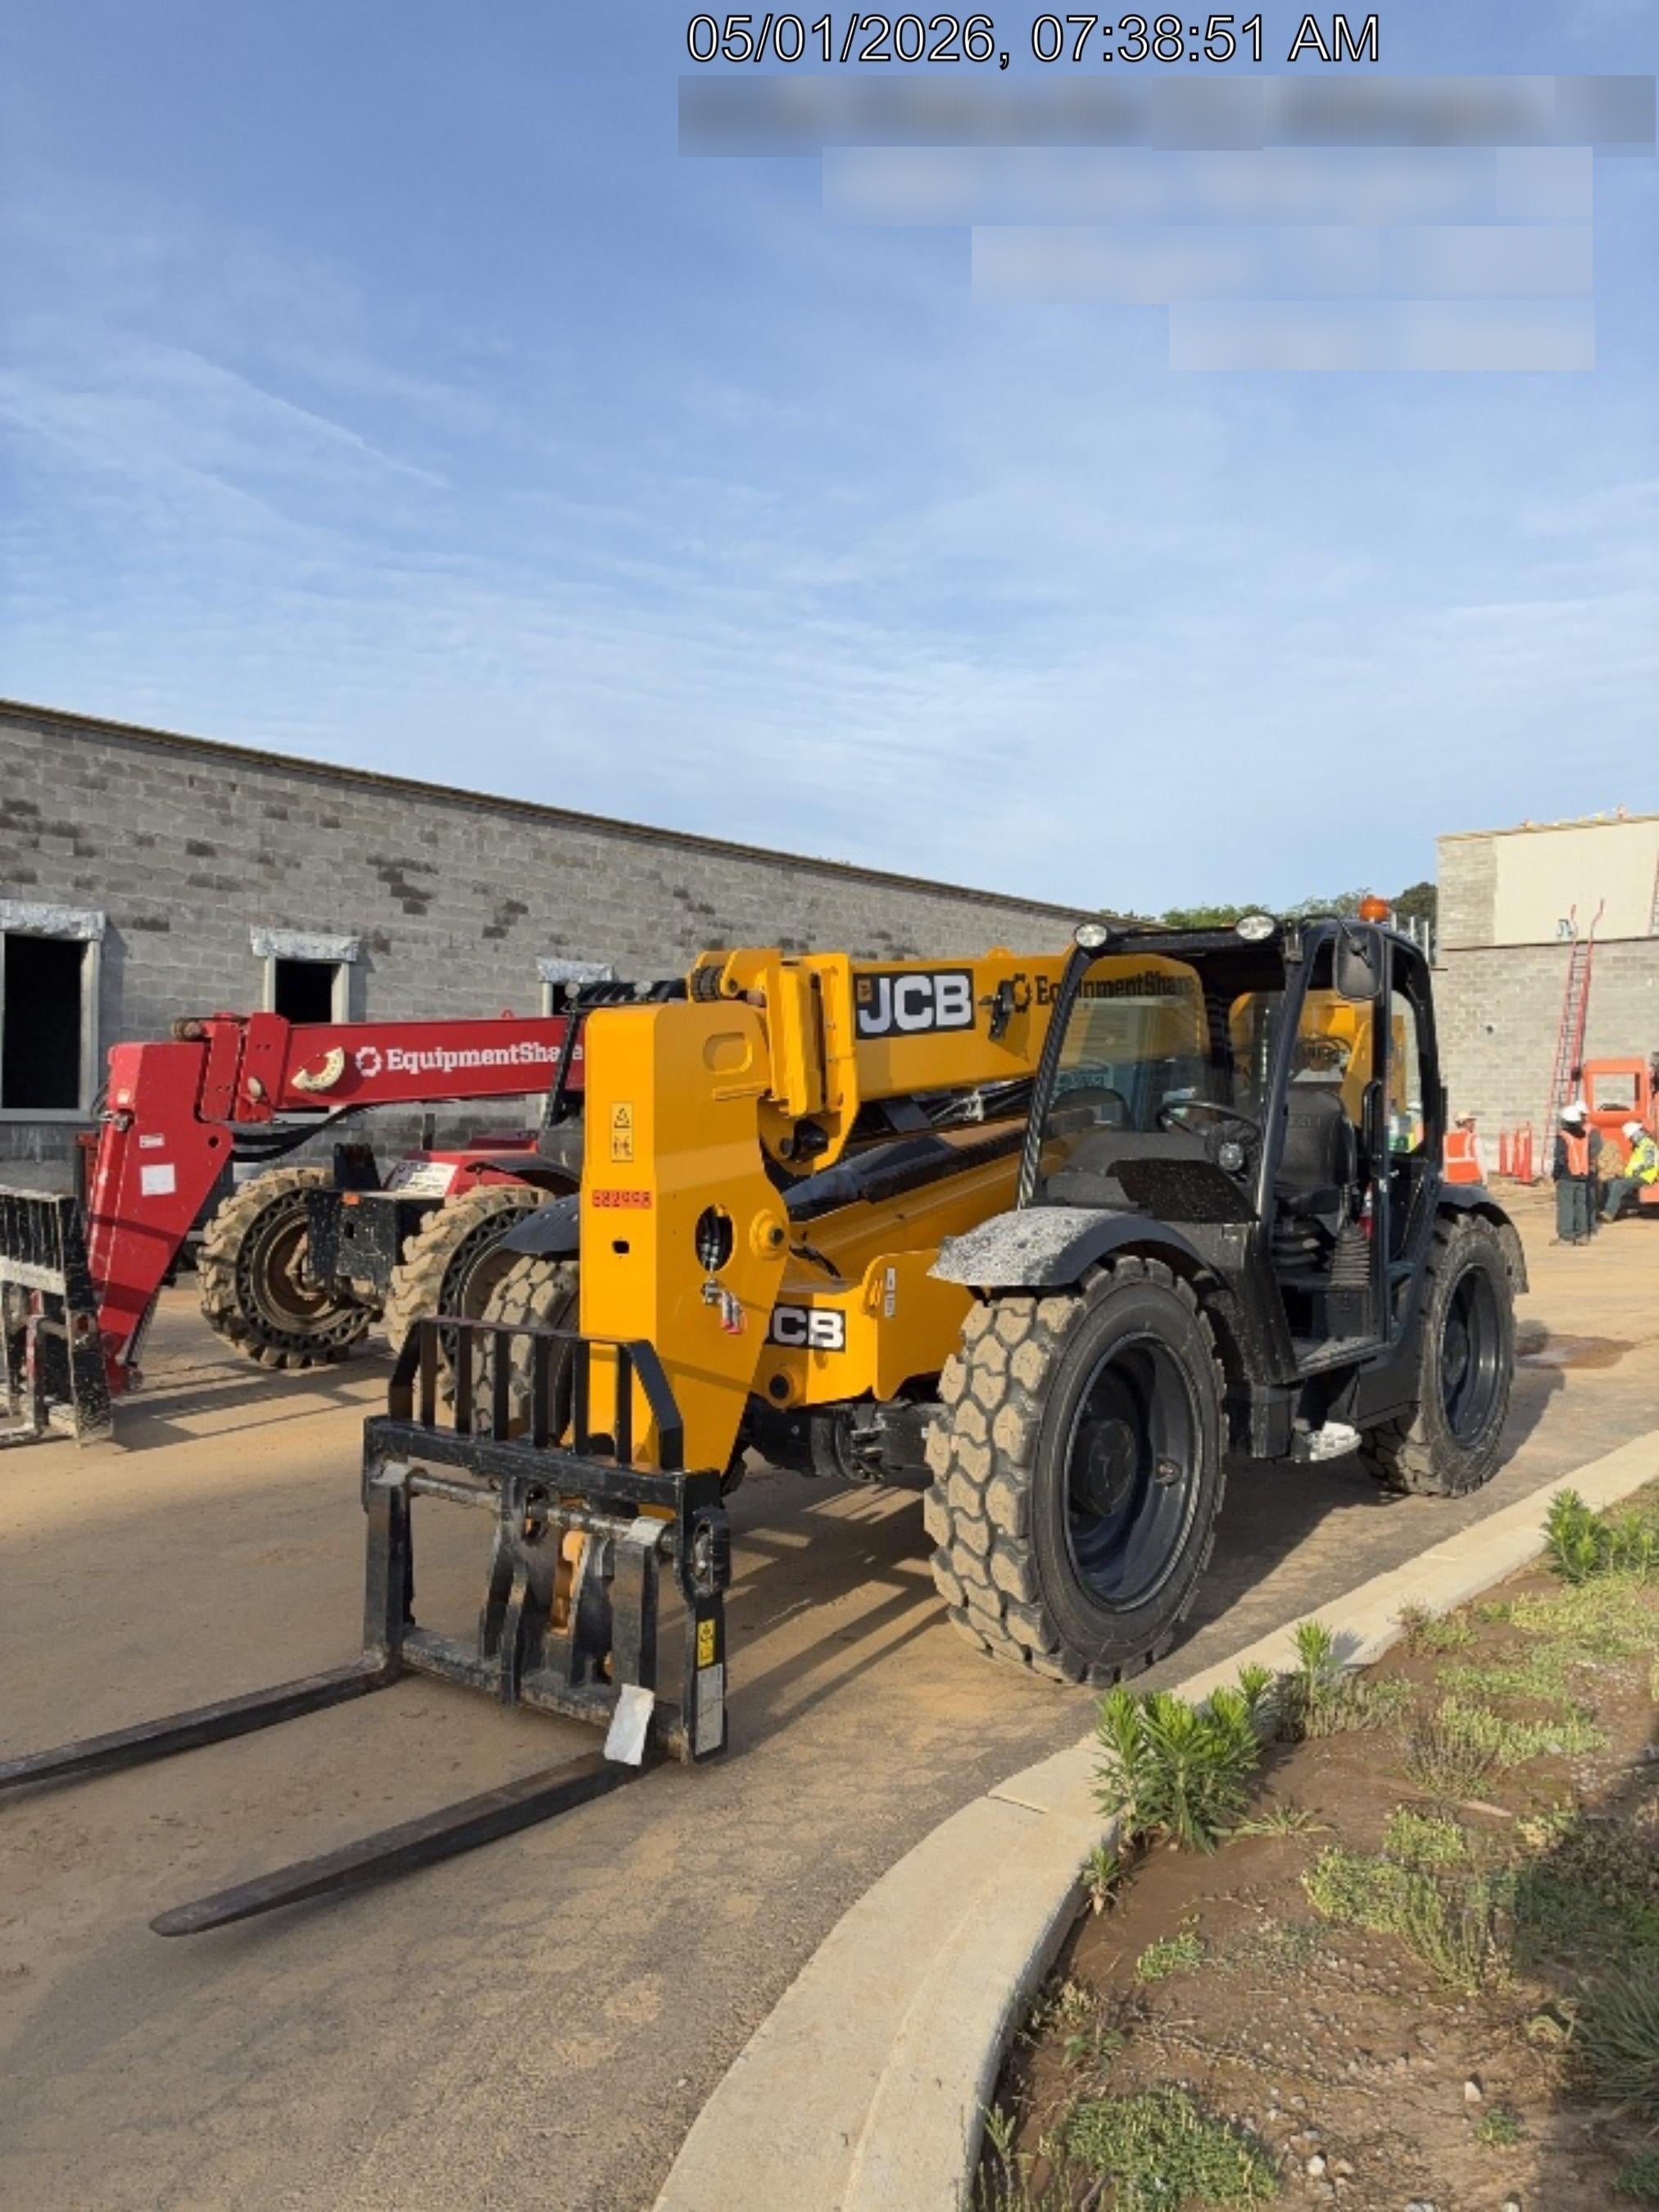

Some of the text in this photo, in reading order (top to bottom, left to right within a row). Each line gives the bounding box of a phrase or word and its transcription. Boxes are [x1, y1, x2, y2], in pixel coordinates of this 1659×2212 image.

[858, 974, 972, 1034] JCB
[385, 1041, 583, 1075] EquipmentShae
[772, 1306, 845, 1349] CB
